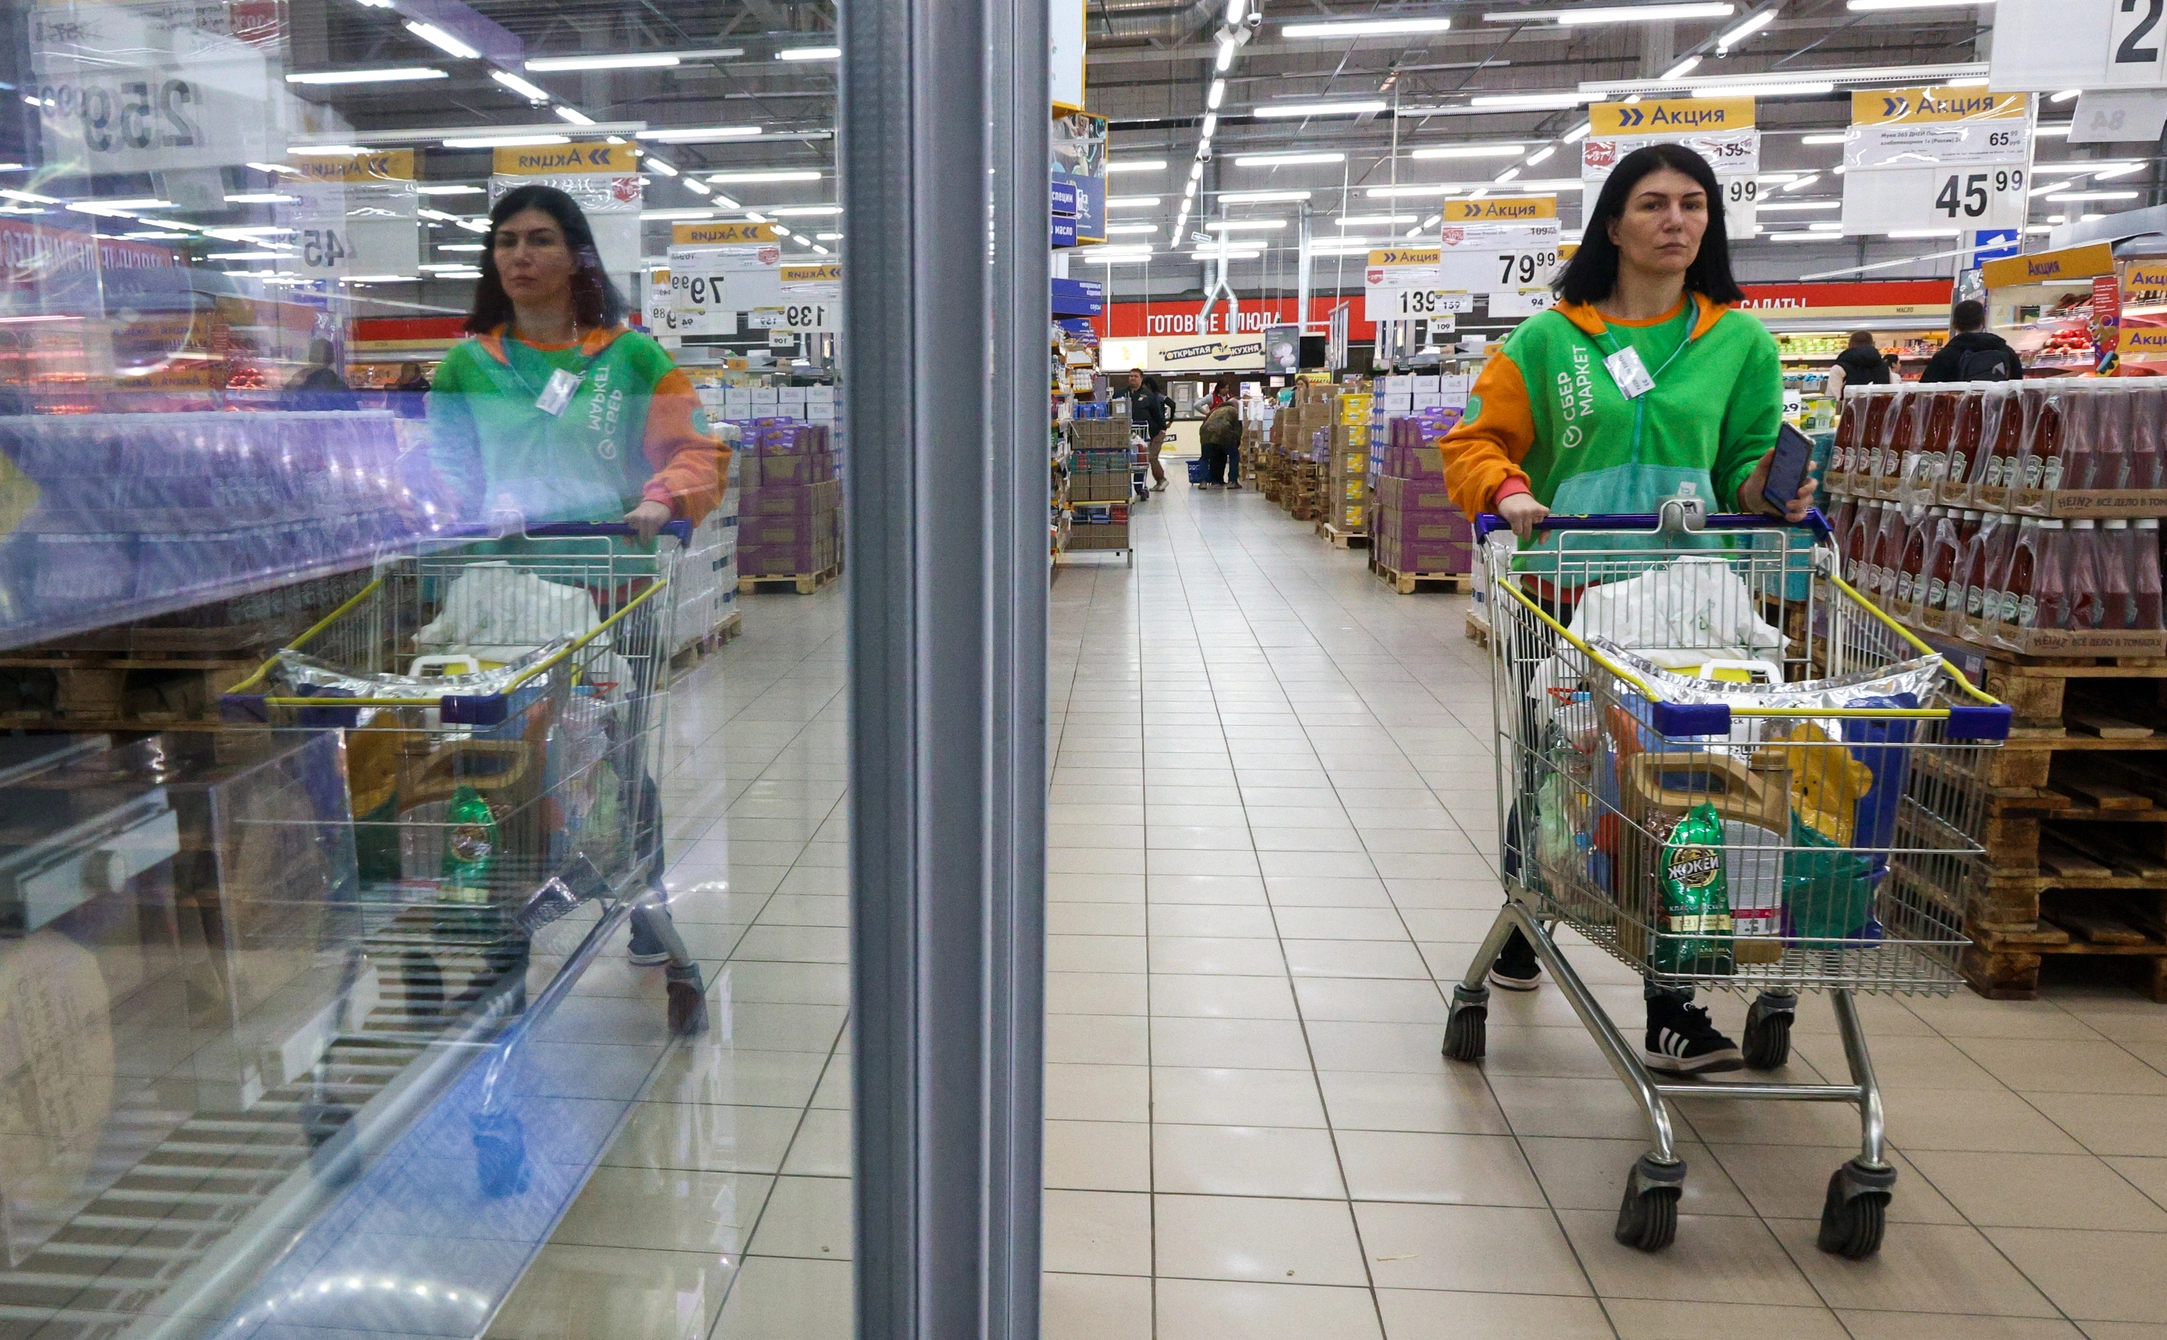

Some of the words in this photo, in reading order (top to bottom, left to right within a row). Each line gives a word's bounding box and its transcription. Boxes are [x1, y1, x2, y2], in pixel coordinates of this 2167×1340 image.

[1916, 97, 1994, 115] Акция
[1651, 105, 1725, 126] Акция
[1989, 132, 2009, 146] 65
[1718, 143, 1744, 157] 159
[1935, 174, 1989, 218] 45
[1995, 170, 2023, 192] 99
[1485, 202, 1536, 217] Акция
[1055, 224, 1073, 236] масло
[1400, 251, 1438, 262] Акция
[1498, 254, 1535, 284] 79
[1537, 252, 1556, 267] 99
[2028, 260, 2061, 276] Акция
[2132, 271, 2167, 286] Акц
[1400, 290, 1435, 314] 139
[1443, 301, 1461, 309] 159
[1531, 298, 1544, 306] 94
[1437, 323, 1451, 331] 109
[1166, 345, 1211, 360] ОТКРЫТАЯ
[1231, 343, 1260, 356] КУХНЯ
[1572, 344, 1595, 417] МАРКЕТ
[1557, 371, 1576, 421] СБЕР
[2058, 497, 2092, 508] HEINZ
[2113, 498, 2138, 507] ДЕЛО
[2141, 499, 2147, 507] В
[2034, 635, 2068, 647] HEINZ
[2090, 637, 2113, 646] ДЕЛО
[2123, 637, 2162, 647] ТОМАТАХ
